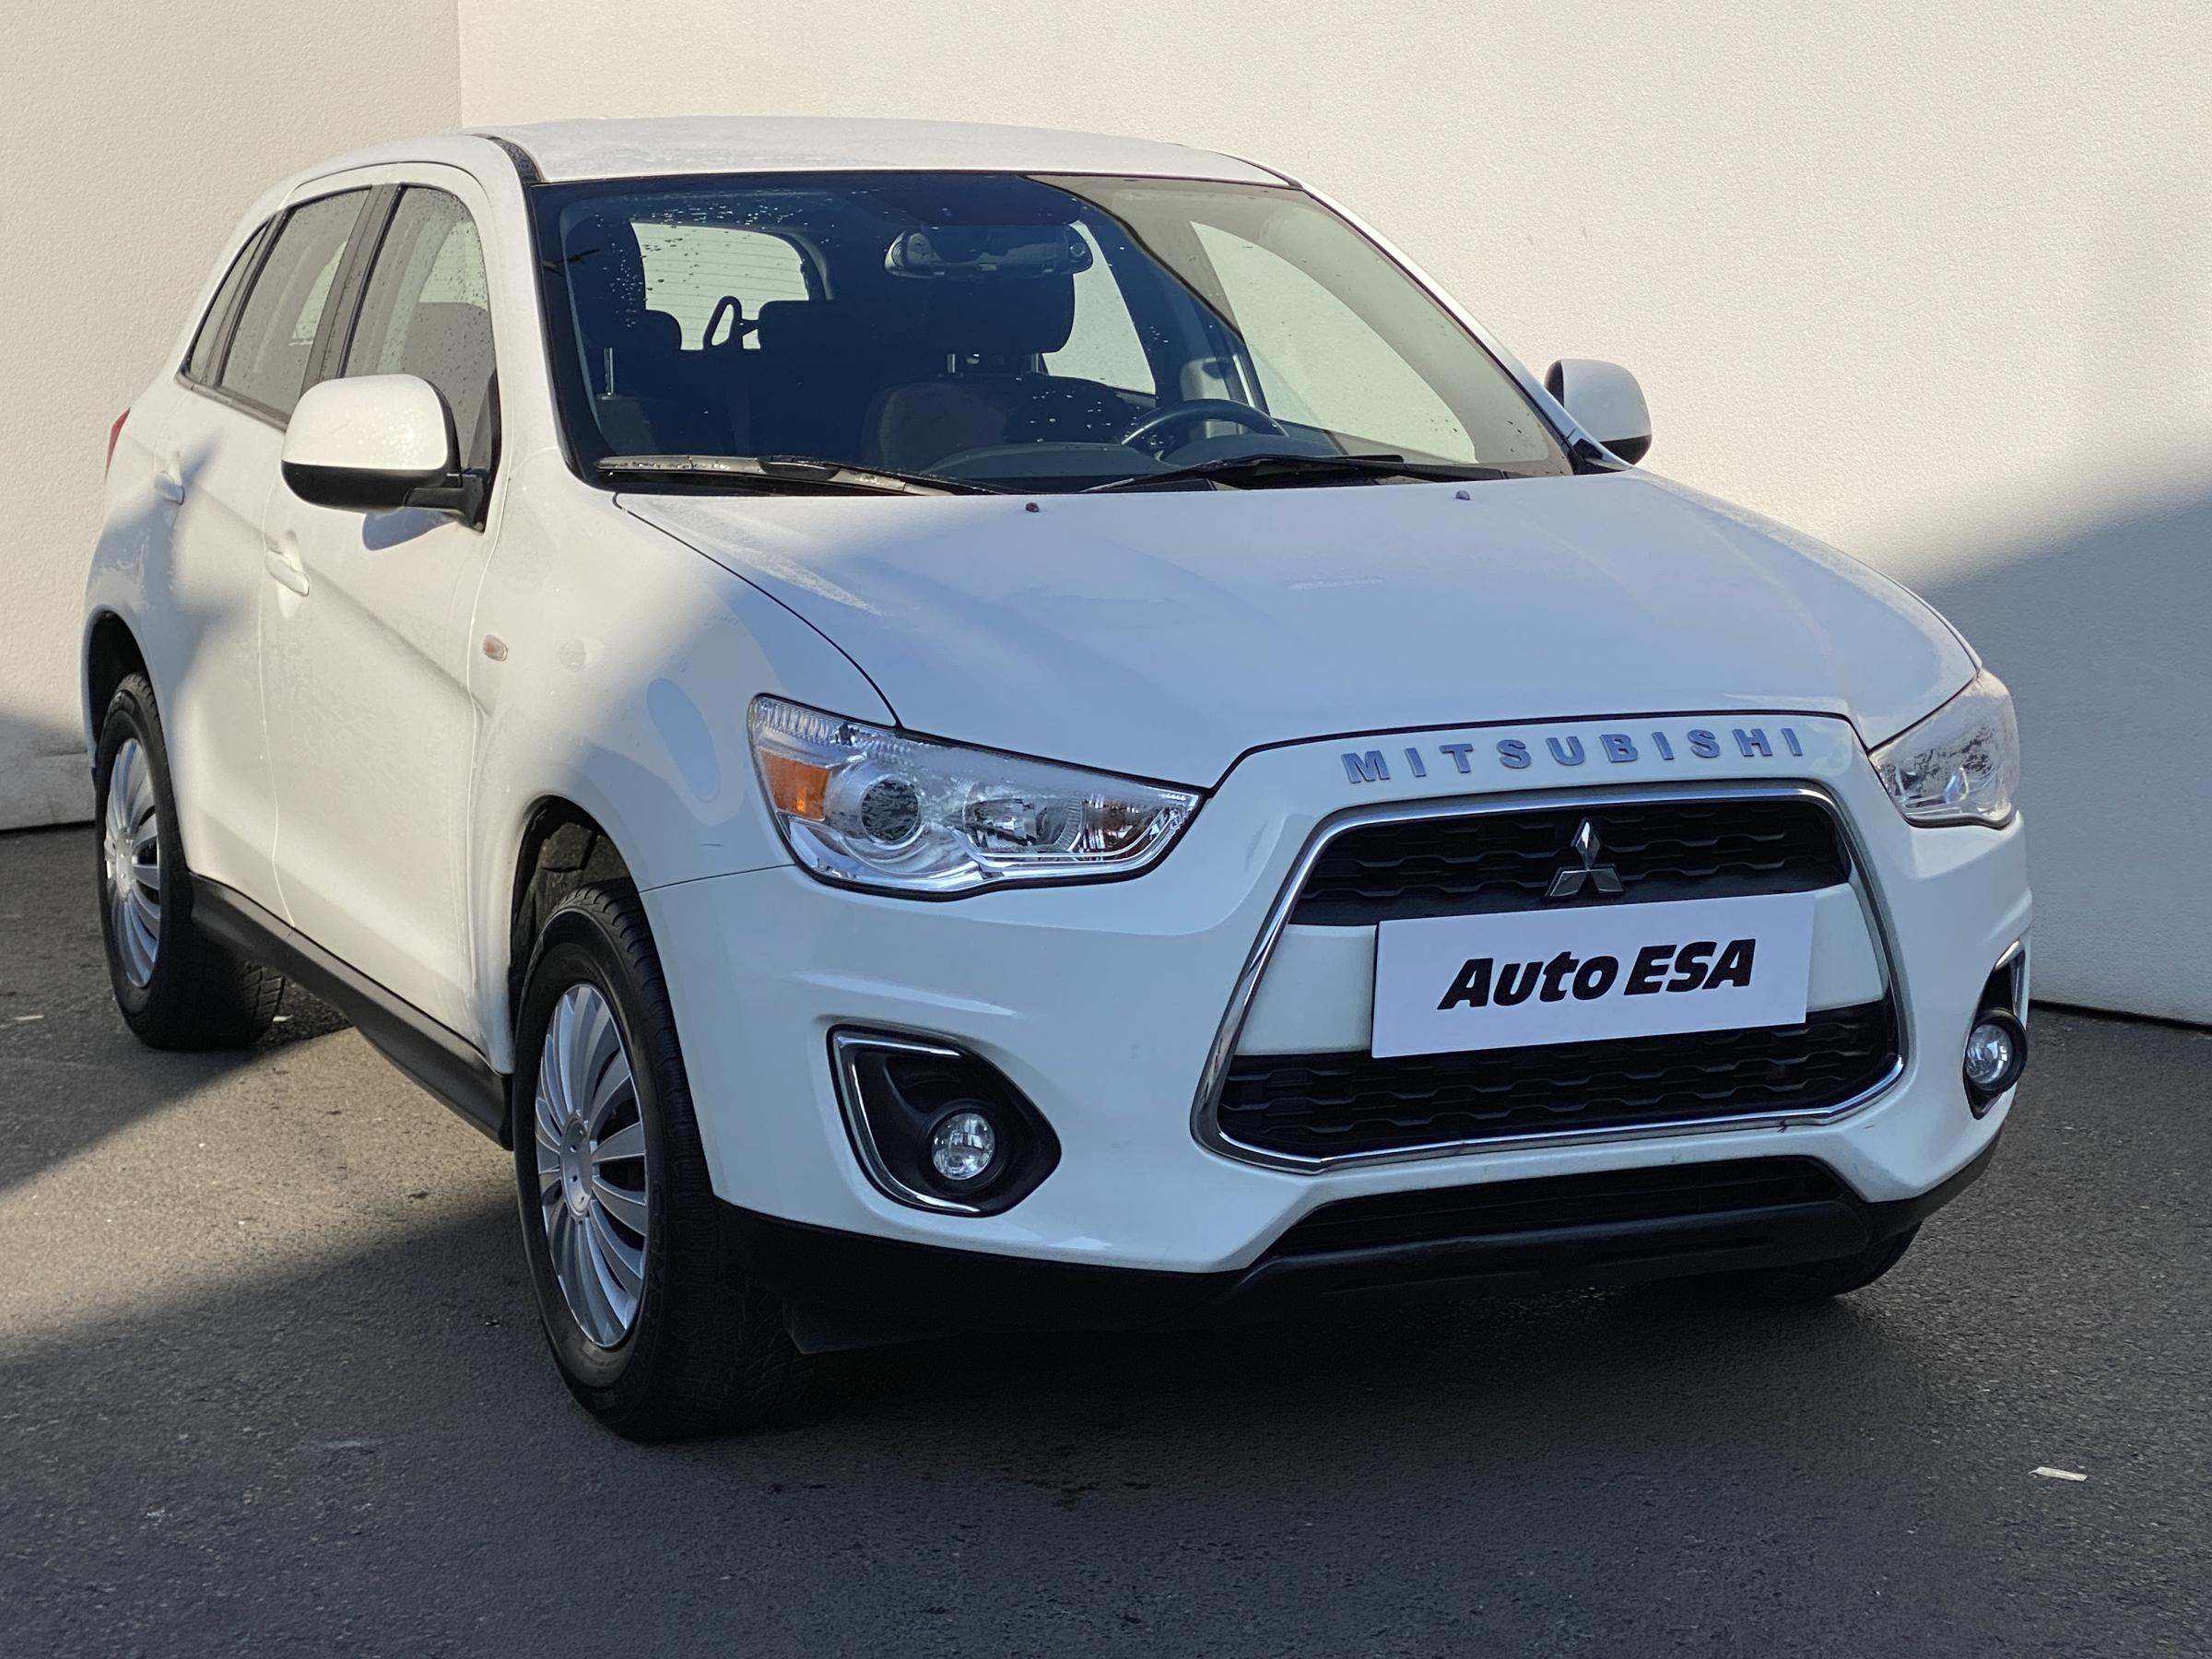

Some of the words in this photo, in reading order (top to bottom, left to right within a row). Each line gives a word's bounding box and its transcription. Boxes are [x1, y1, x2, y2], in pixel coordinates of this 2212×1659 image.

[1342, 728, 1803, 783] MITSUBISHI
[1436, 951, 1618, 1010] Auto
[1623, 938, 1757, 996] ESA
